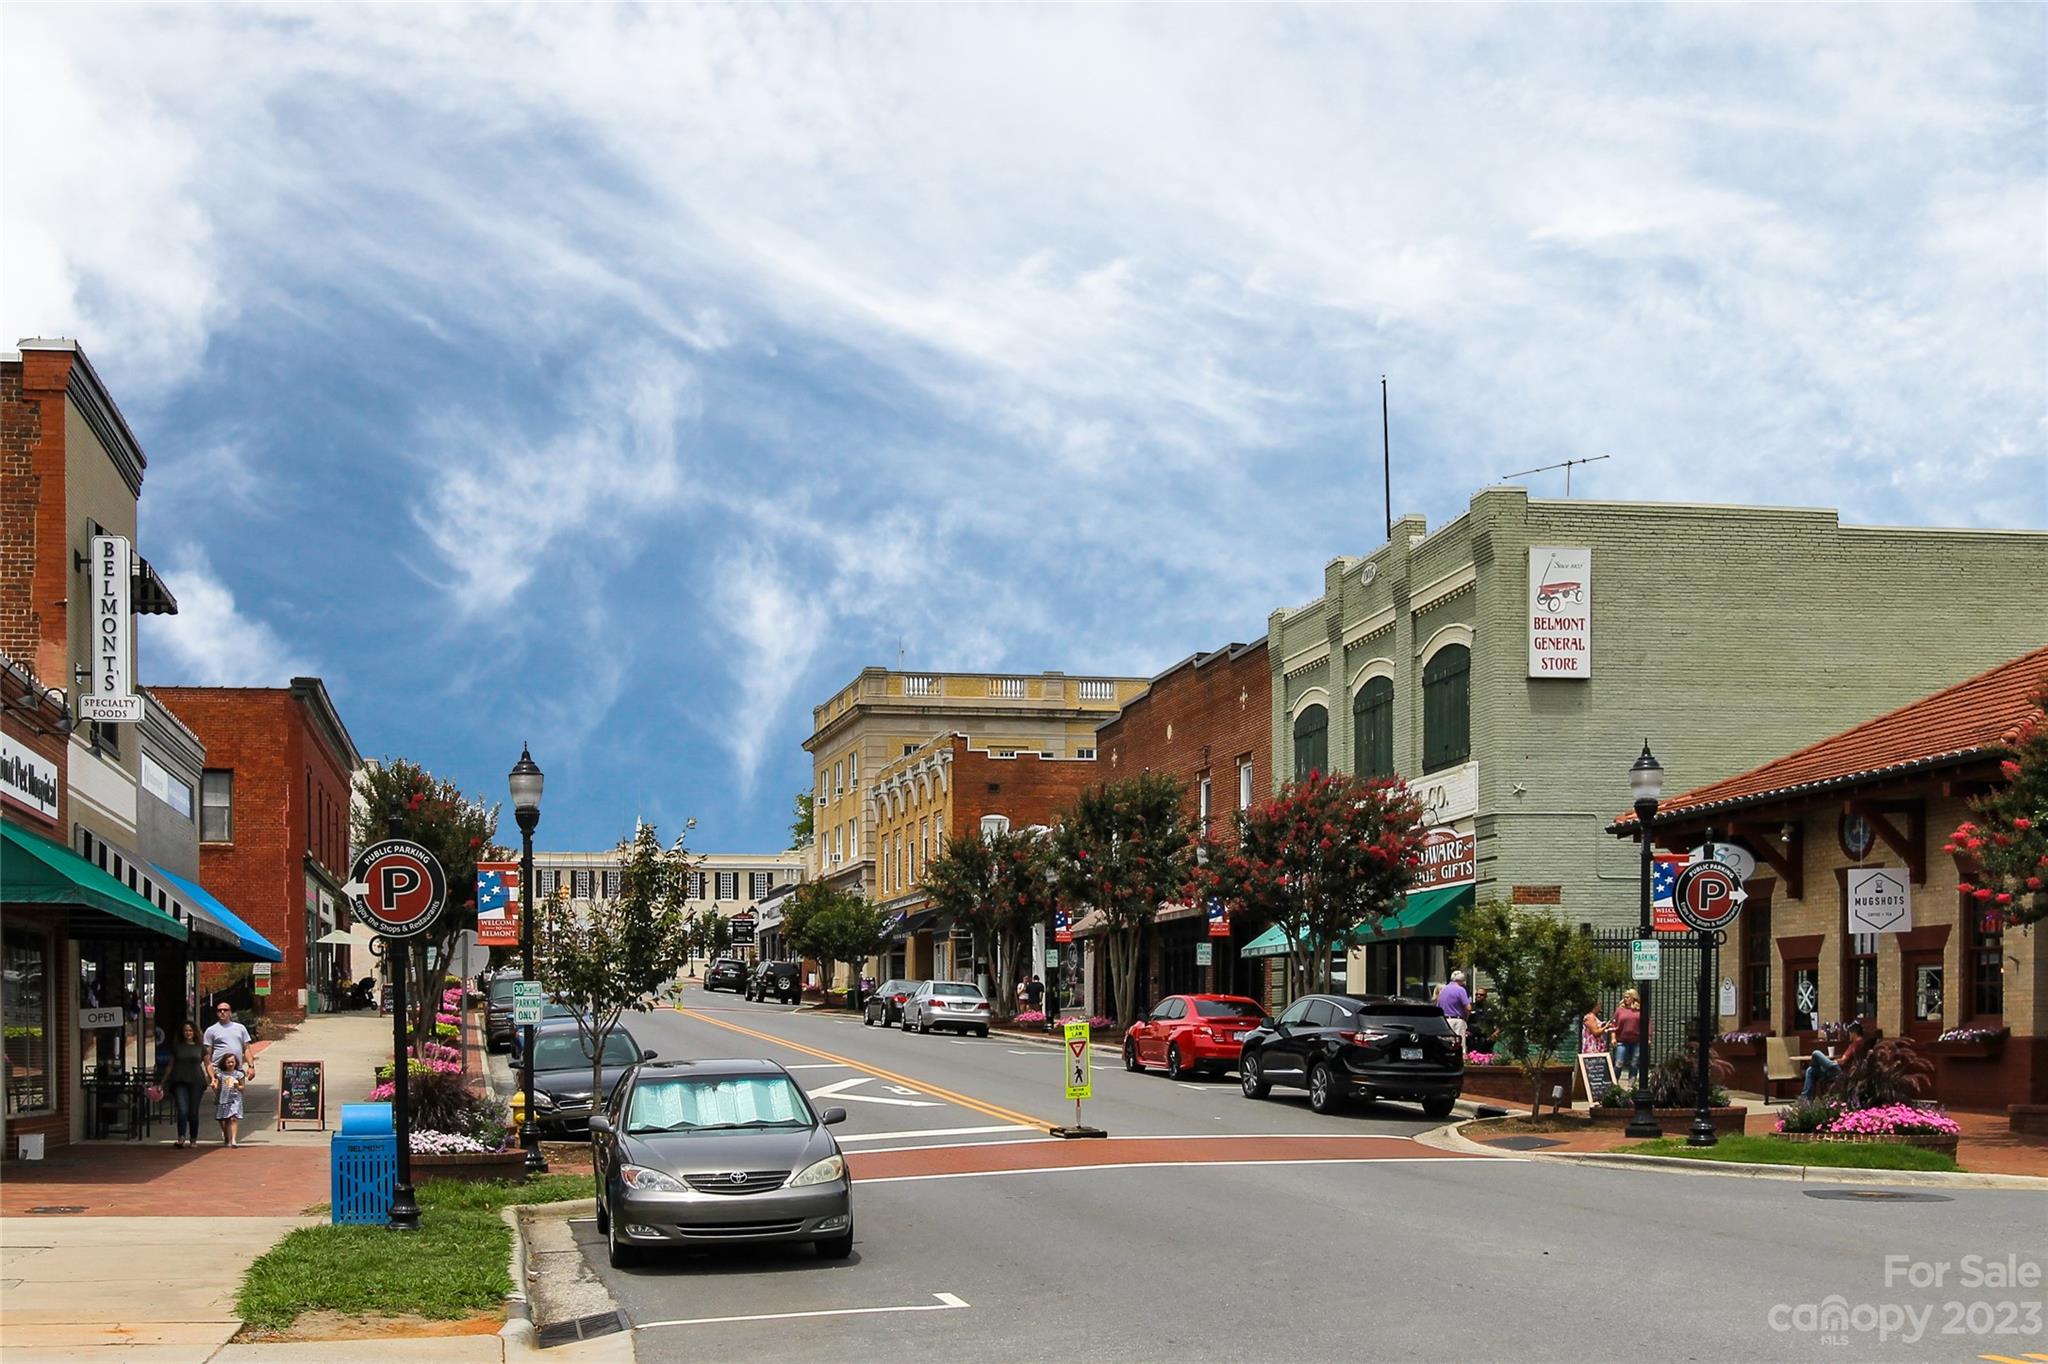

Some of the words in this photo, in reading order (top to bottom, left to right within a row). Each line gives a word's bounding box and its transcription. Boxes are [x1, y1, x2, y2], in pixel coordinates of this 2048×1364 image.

[101, 541, 119, 691] BELMONT'S
[1534, 617, 1586, 631] BELMONT
[1534, 636, 1586, 651] GENERAL
[1541, 656, 1578, 670] STORE
[84, 698, 136, 708] SPECIALTY
[93, 709, 127, 718] FOODS
[15, 755, 28, 793] Pet
[28, 762, 57, 811] Hospital
[363, 845, 393, 866] PUBLIC
[393, 845, 430, 864] PARKING
[1441, 860, 1473, 879] GIFTS
[1689, 863, 1709, 877] PUBLIC
[1710, 863, 1735, 879] PARKING
[380, 865, 421, 911] P
[1698, 878, 1727, 911] P
[1855, 896, 1905, 906] MUGSHOTS
[355, 900, 369, 919] Enjoy
[367, 915, 379, 928] the
[379, 923, 401, 934] Shops
[402, 924, 409, 932] &
[409, 900, 440, 931] Restaurants
[1634, 942, 1641, 951] 2
[1634, 953, 1658, 961] PARKING
[514, 983, 524, 996] 30
[515, 998, 541, 1009] PARKING
[88, 1012, 115, 1023] OPEN
[518, 1010, 538, 1021] ONLY
[347, 1144, 384, 1153] BELMONT
